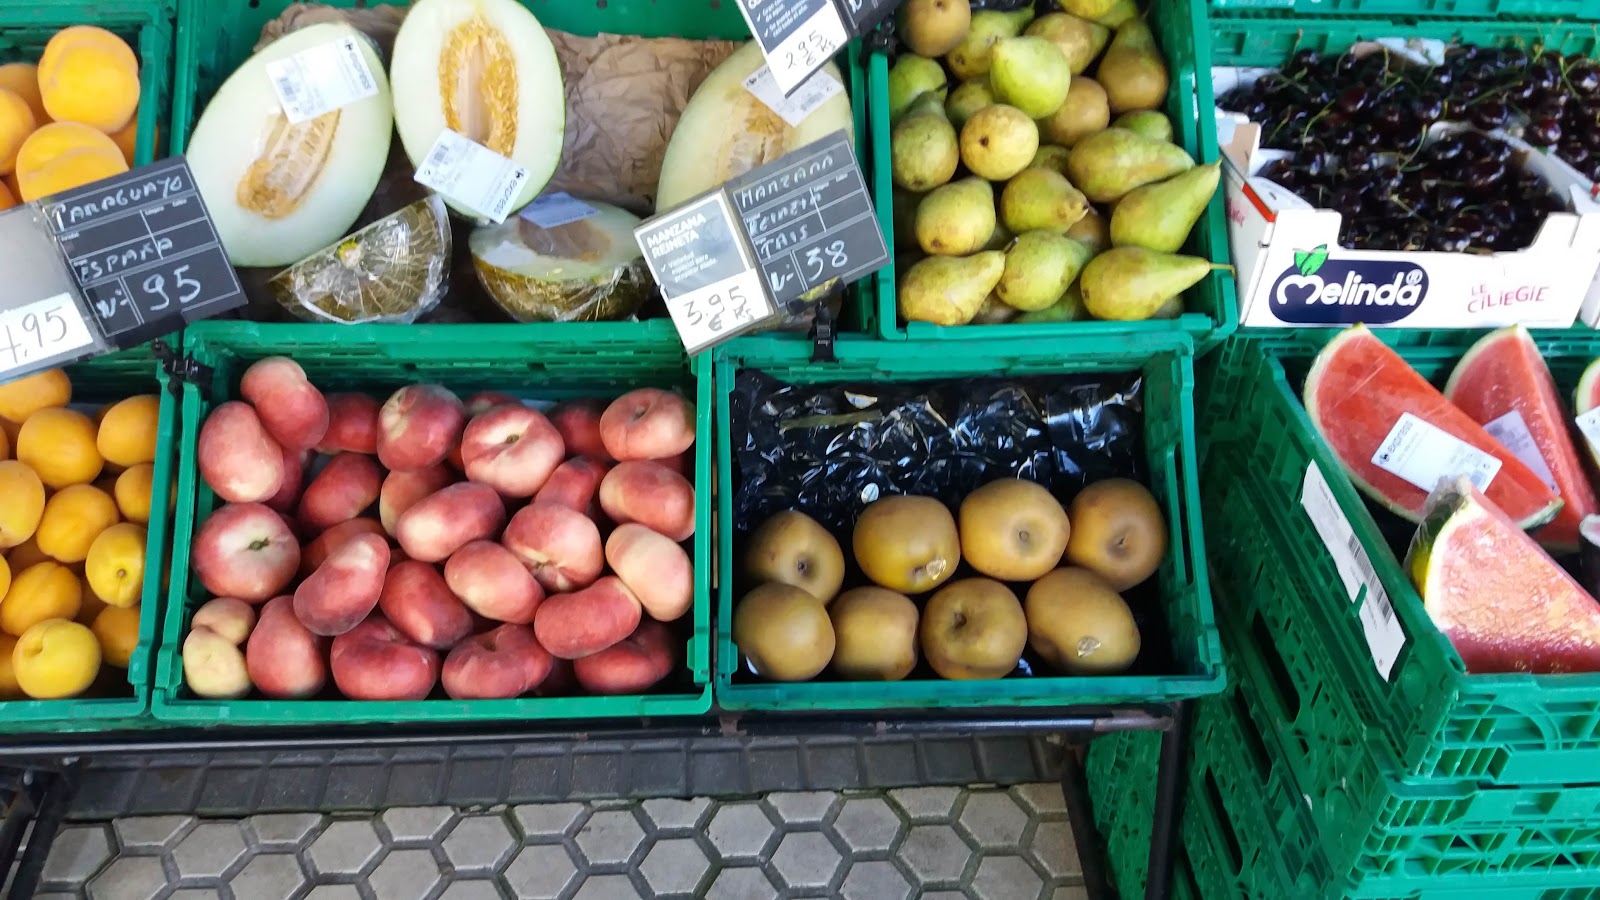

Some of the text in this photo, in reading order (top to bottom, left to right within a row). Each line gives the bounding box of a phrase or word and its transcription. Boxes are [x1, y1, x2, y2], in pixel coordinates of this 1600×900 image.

[52, 175, 182, 232] PARAGUAYO
[646, 212, 707, 249] MANZANA
[651, 229, 700, 259] REINETA
[805, 239, 849, 282] 38
[142, 264, 202, 311] 95
[683, 285, 747, 326] 3.95
[1467, 285, 1551, 314] CILIEGIE
